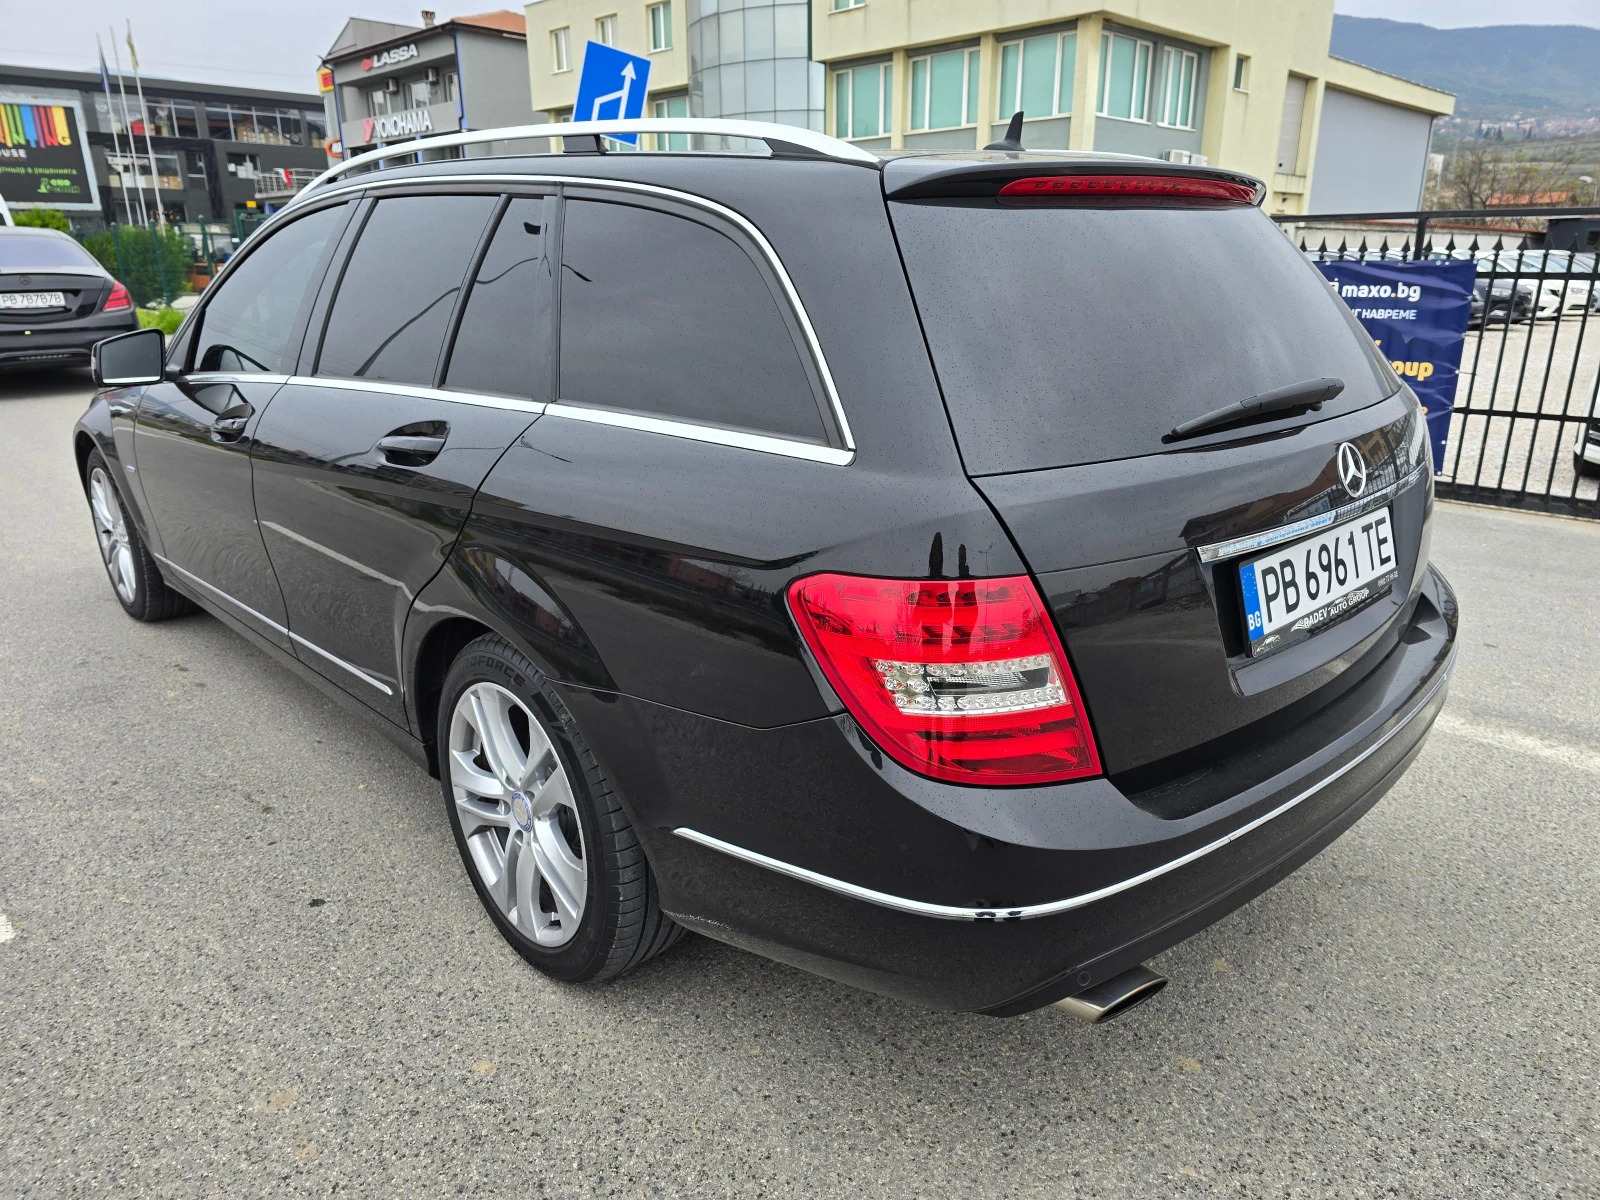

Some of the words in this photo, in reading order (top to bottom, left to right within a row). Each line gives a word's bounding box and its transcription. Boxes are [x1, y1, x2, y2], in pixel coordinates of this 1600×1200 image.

[372, 44, 418, 68] LASSA
[374, 110, 433, 138] YOKOHAMA
[0, 149, 27, 158] USE
[2, 295, 18, 305] PB
[1341, 282, 1421, 302] maxo.bg
[1361, 309, 1418, 320] НАВРЕМЕ
[1389, 361, 1434, 381] oup
[1261, 558, 1301, 624] PB
[1304, 530, 1361, 601] 6961
[1361, 516, 1392, 572] TE
[1247, 611, 1262, 631] BG
[1303, 606, 1328, 629] RADEV
[1329, 600, 1348, 617] AUTO
